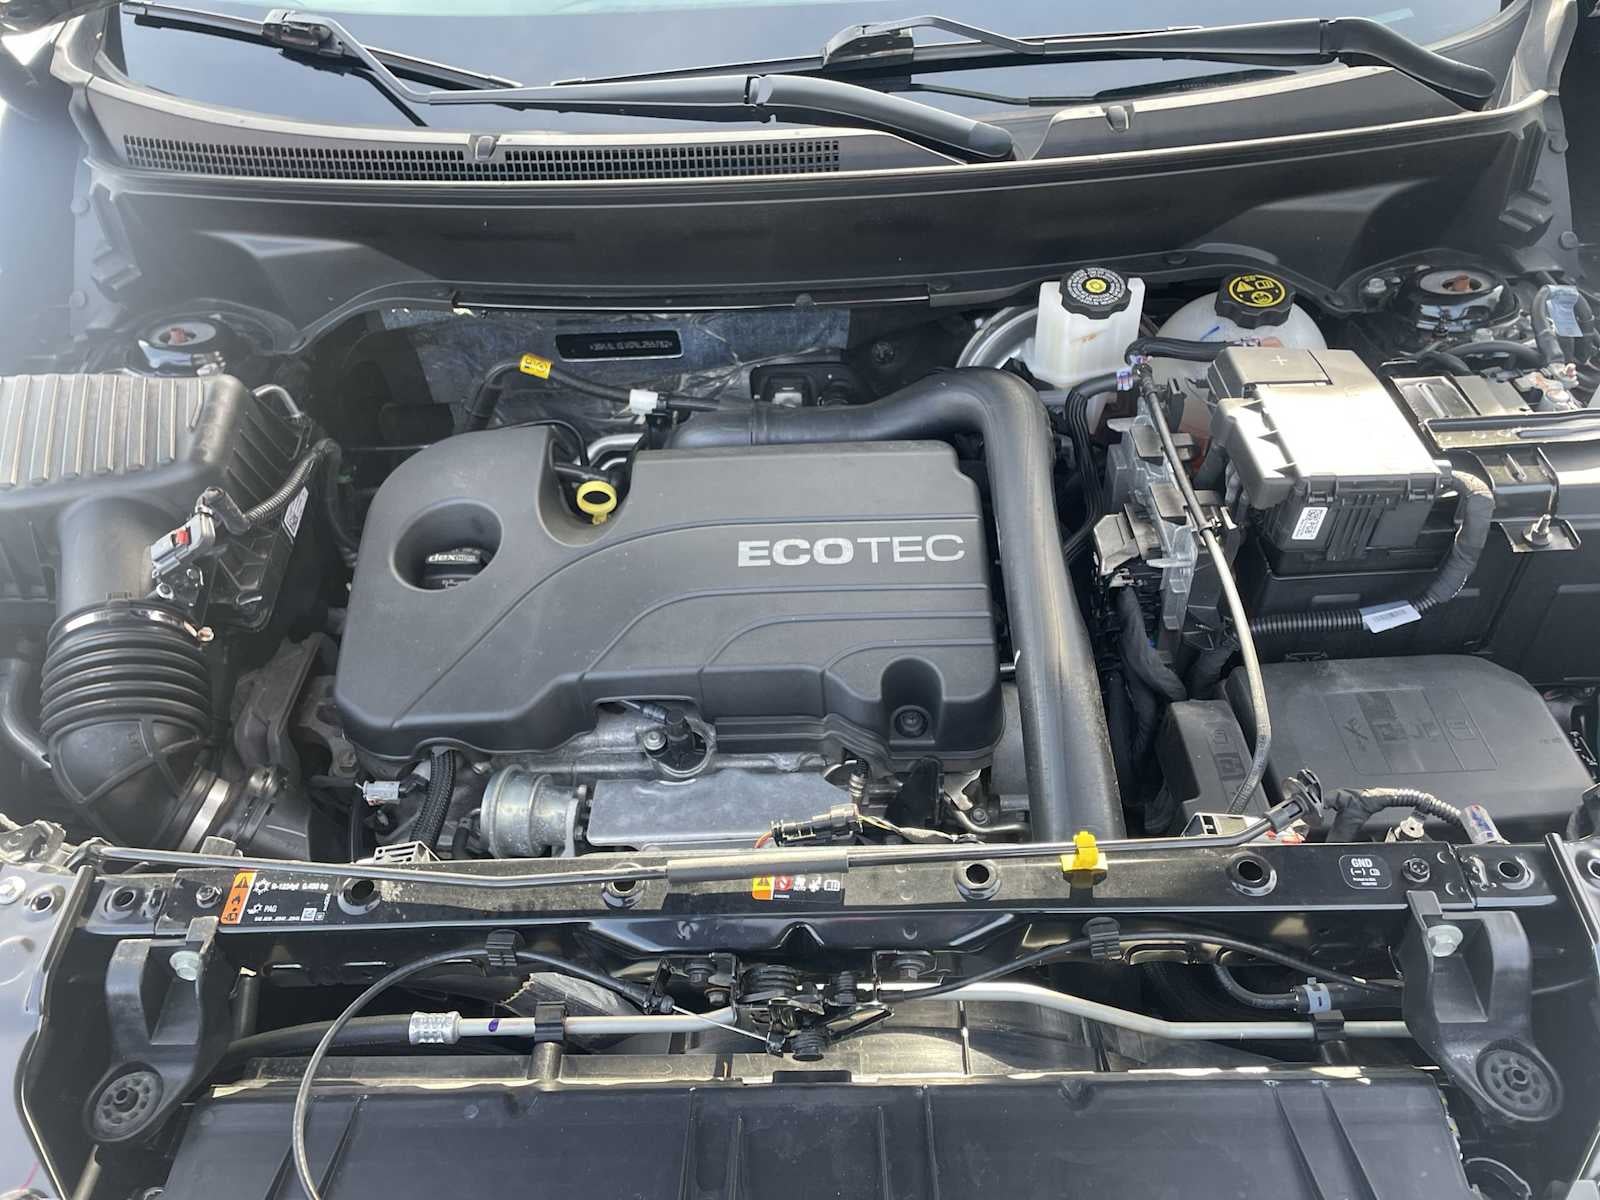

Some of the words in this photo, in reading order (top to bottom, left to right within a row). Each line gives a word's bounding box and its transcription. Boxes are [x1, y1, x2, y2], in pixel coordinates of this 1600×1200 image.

[738, 534, 965, 567] ECOTEC
[1351, 858, 1373, 868] GND
[263, 904, 278, 913] PAG
